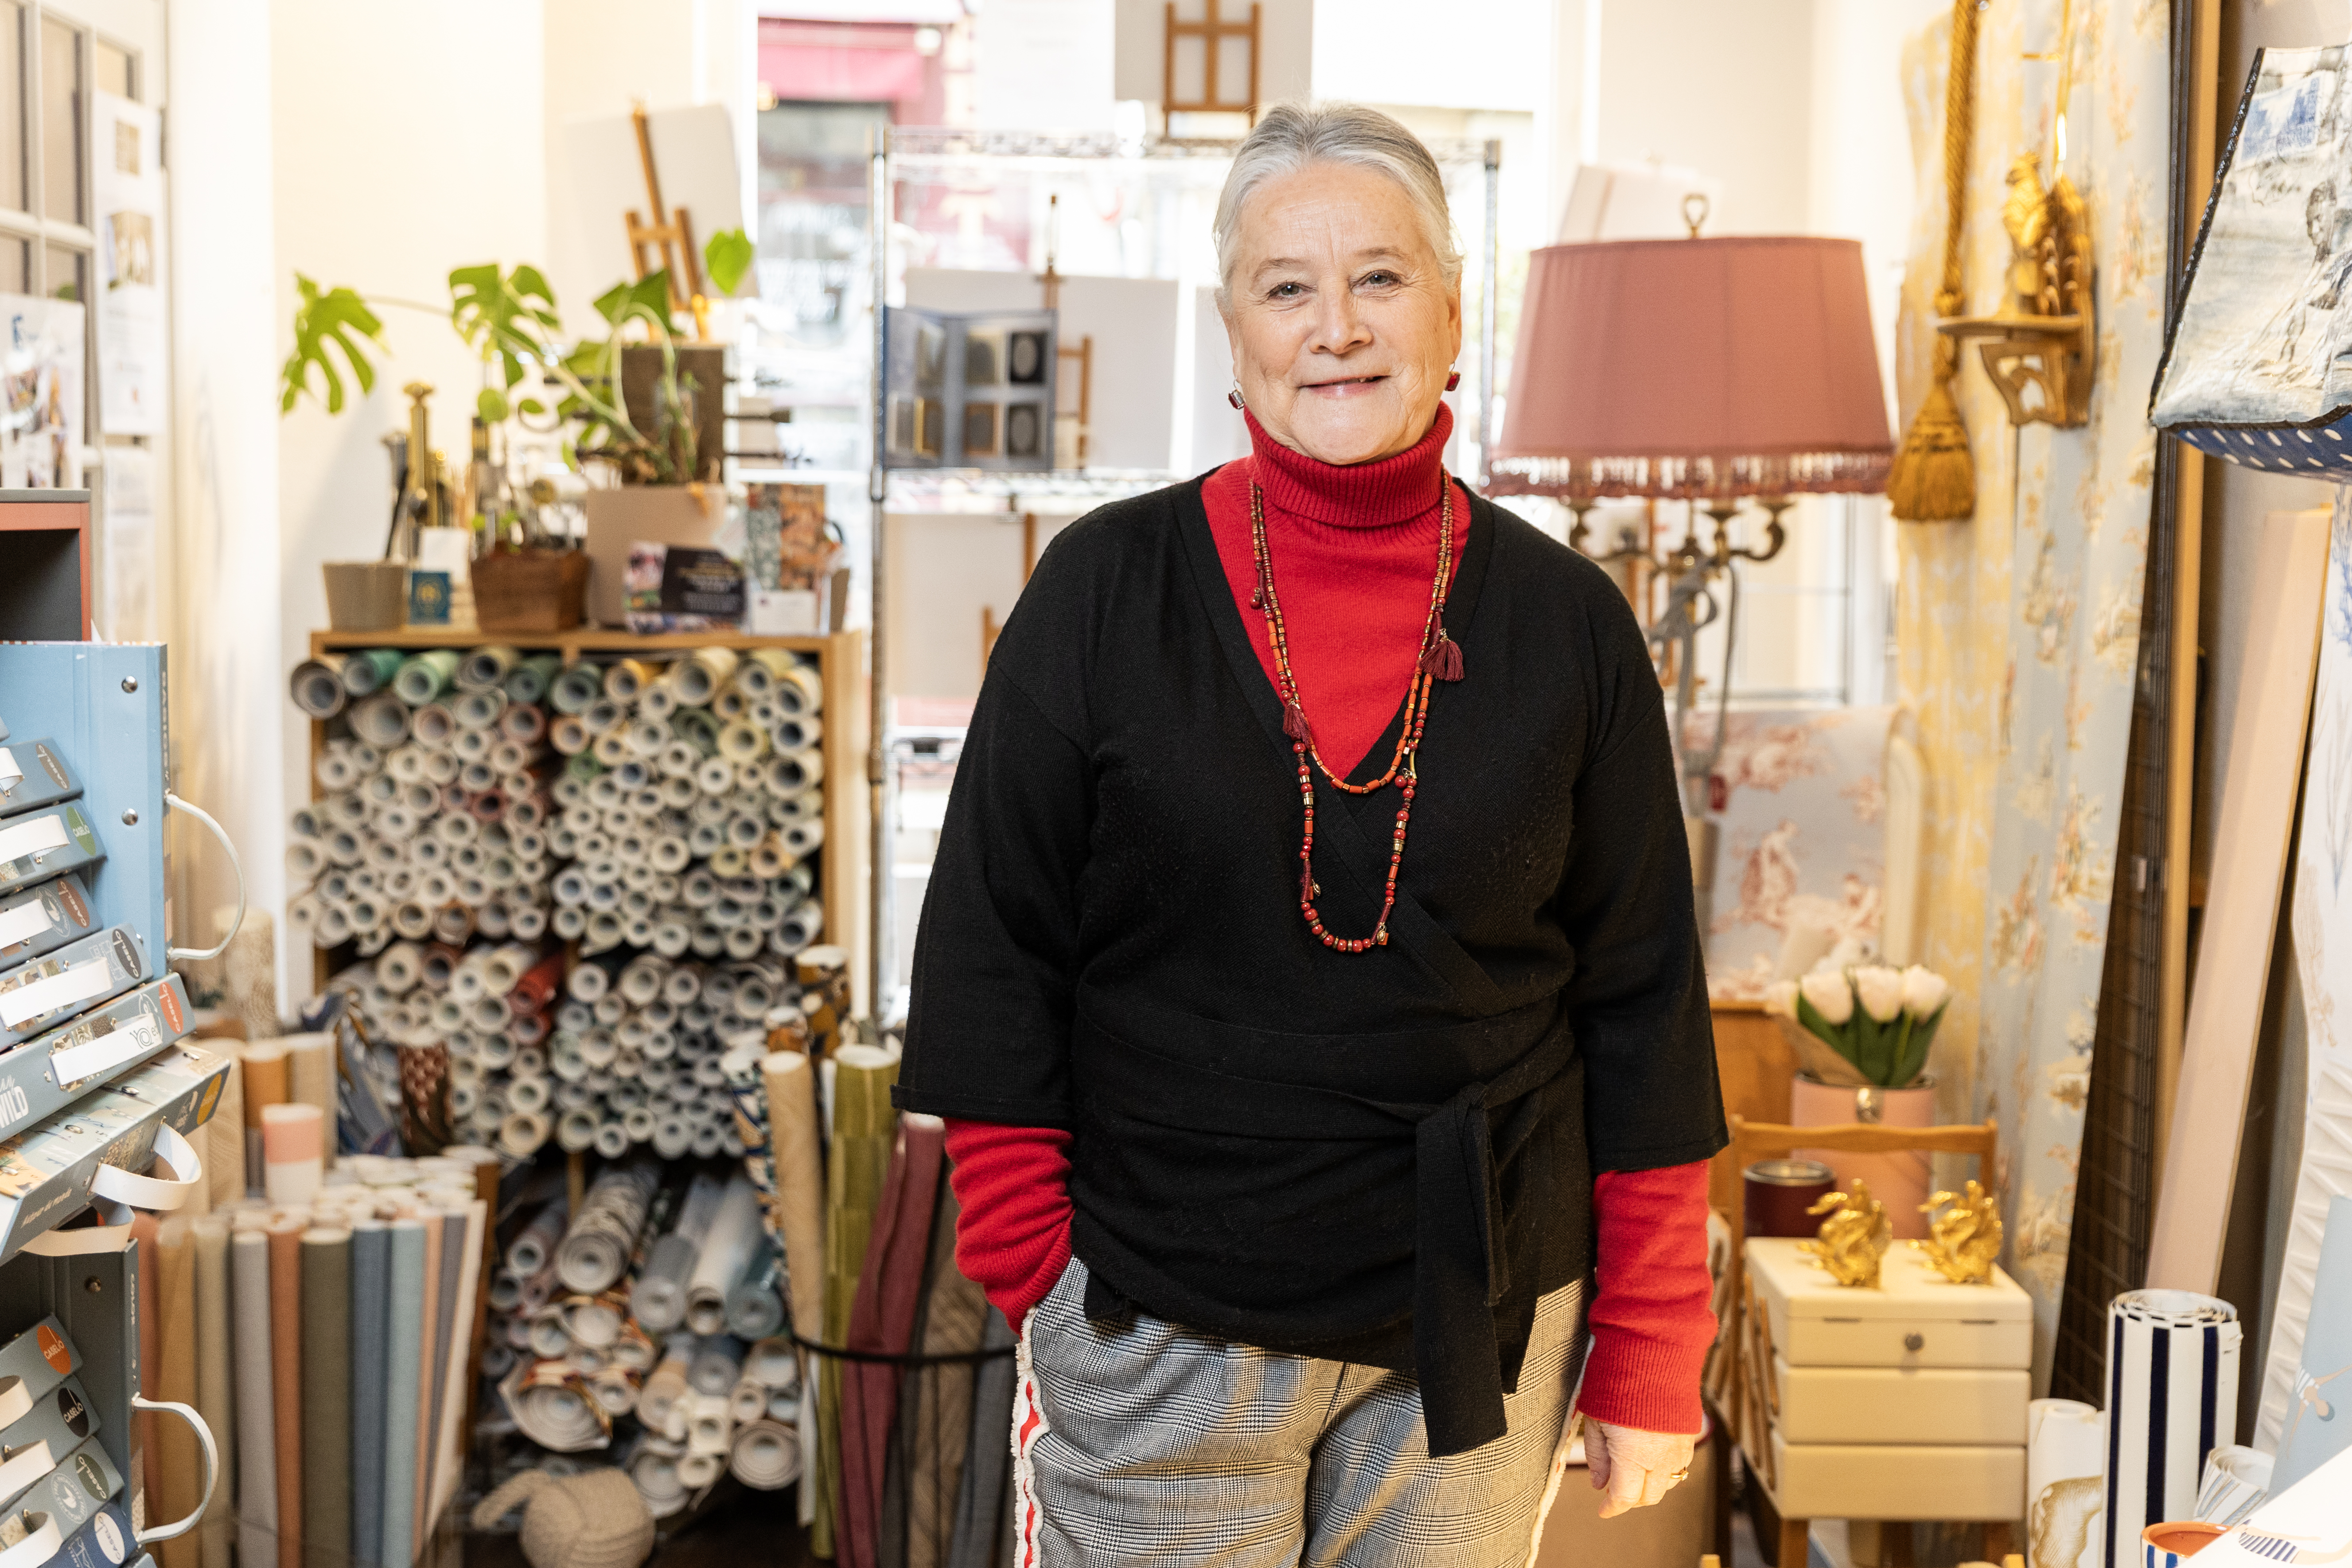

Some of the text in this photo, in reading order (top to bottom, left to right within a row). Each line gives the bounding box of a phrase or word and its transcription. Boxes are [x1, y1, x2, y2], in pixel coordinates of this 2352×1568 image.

[113, 930, 139, 977] CASELIO
[45, 1326, 64, 1360] CASELIO
[63, 1388, 83, 1423] CASELIO
[77, 1456, 107, 1499] CASELIO
